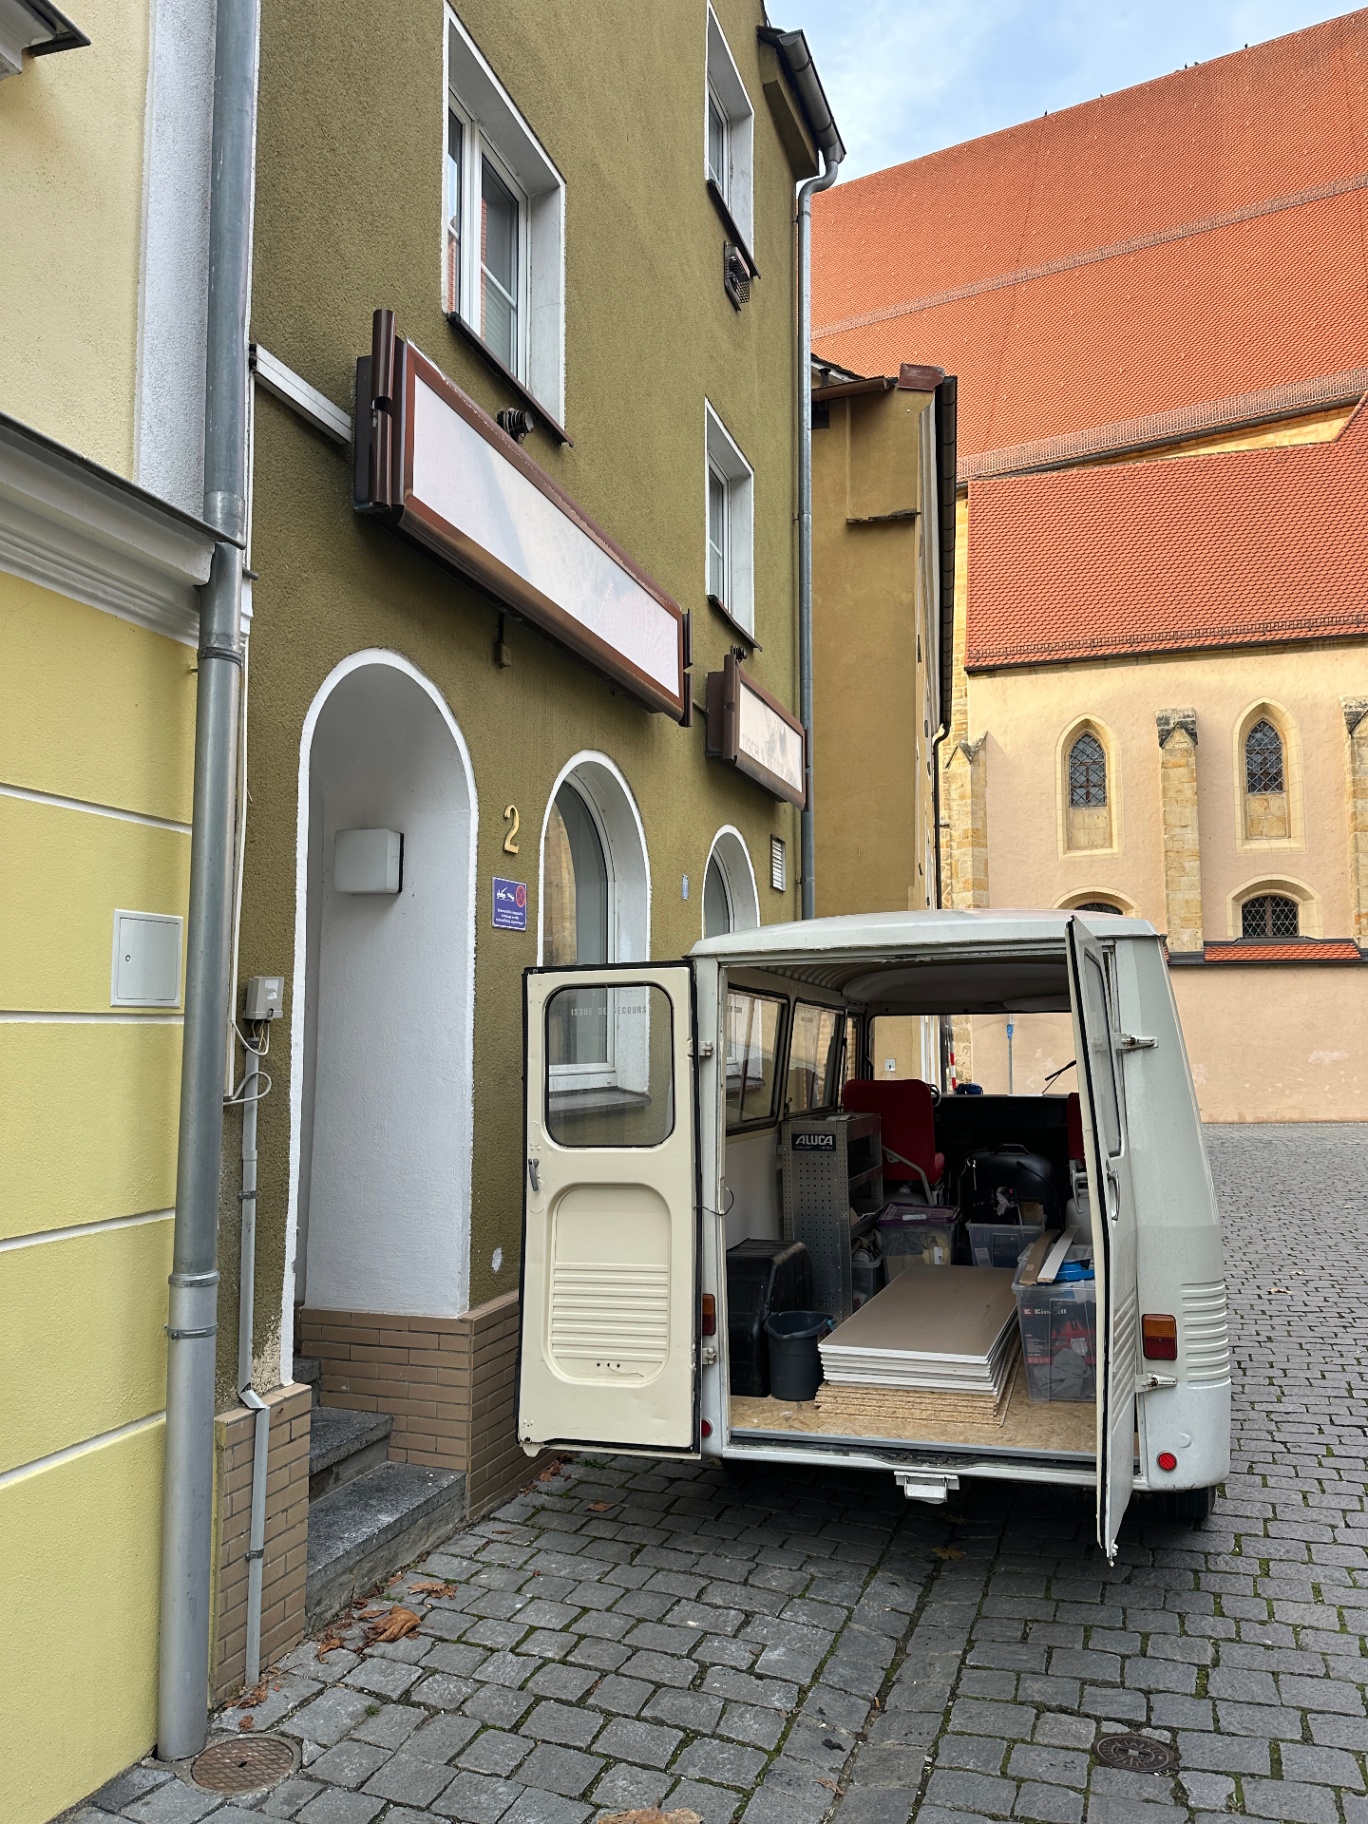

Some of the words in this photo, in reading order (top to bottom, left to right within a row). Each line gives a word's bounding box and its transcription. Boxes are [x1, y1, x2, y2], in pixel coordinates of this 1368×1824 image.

[503, 804, 520, 855] 2
[571, 1007, 593, 1017] ISSUE
[597, 1006, 607, 1016] DE
[614, 1005, 647, 1015] SECOURS
[795, 1134, 833, 1146] ALUCA
